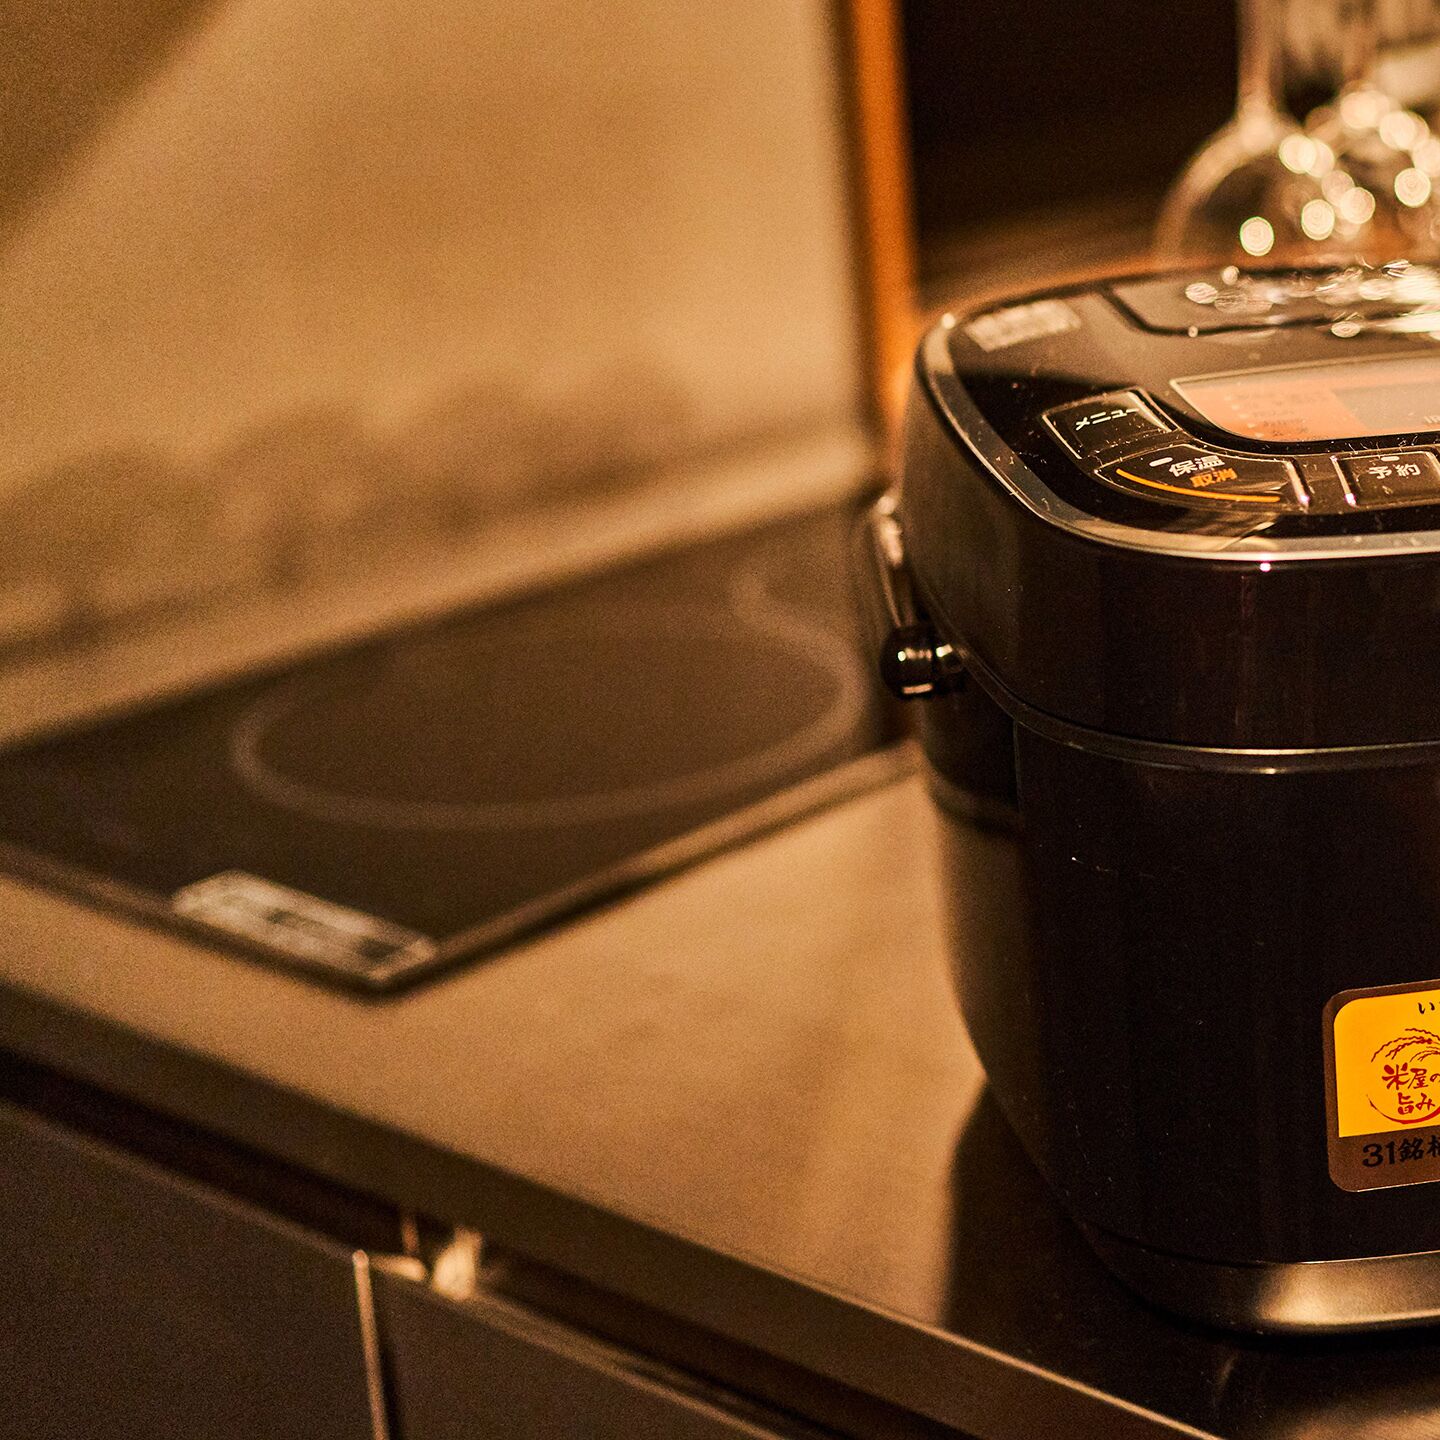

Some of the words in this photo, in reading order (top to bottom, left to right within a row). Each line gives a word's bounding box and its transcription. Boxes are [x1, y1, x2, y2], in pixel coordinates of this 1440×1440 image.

[1075, 408, 1140, 431] メニュー
[1168, 454, 1226, 478] 保温
[1189, 467, 1239, 488] 取消
[1368, 462, 1422, 480] 予約
[1397, 1092, 1436, 1115] 旨み
